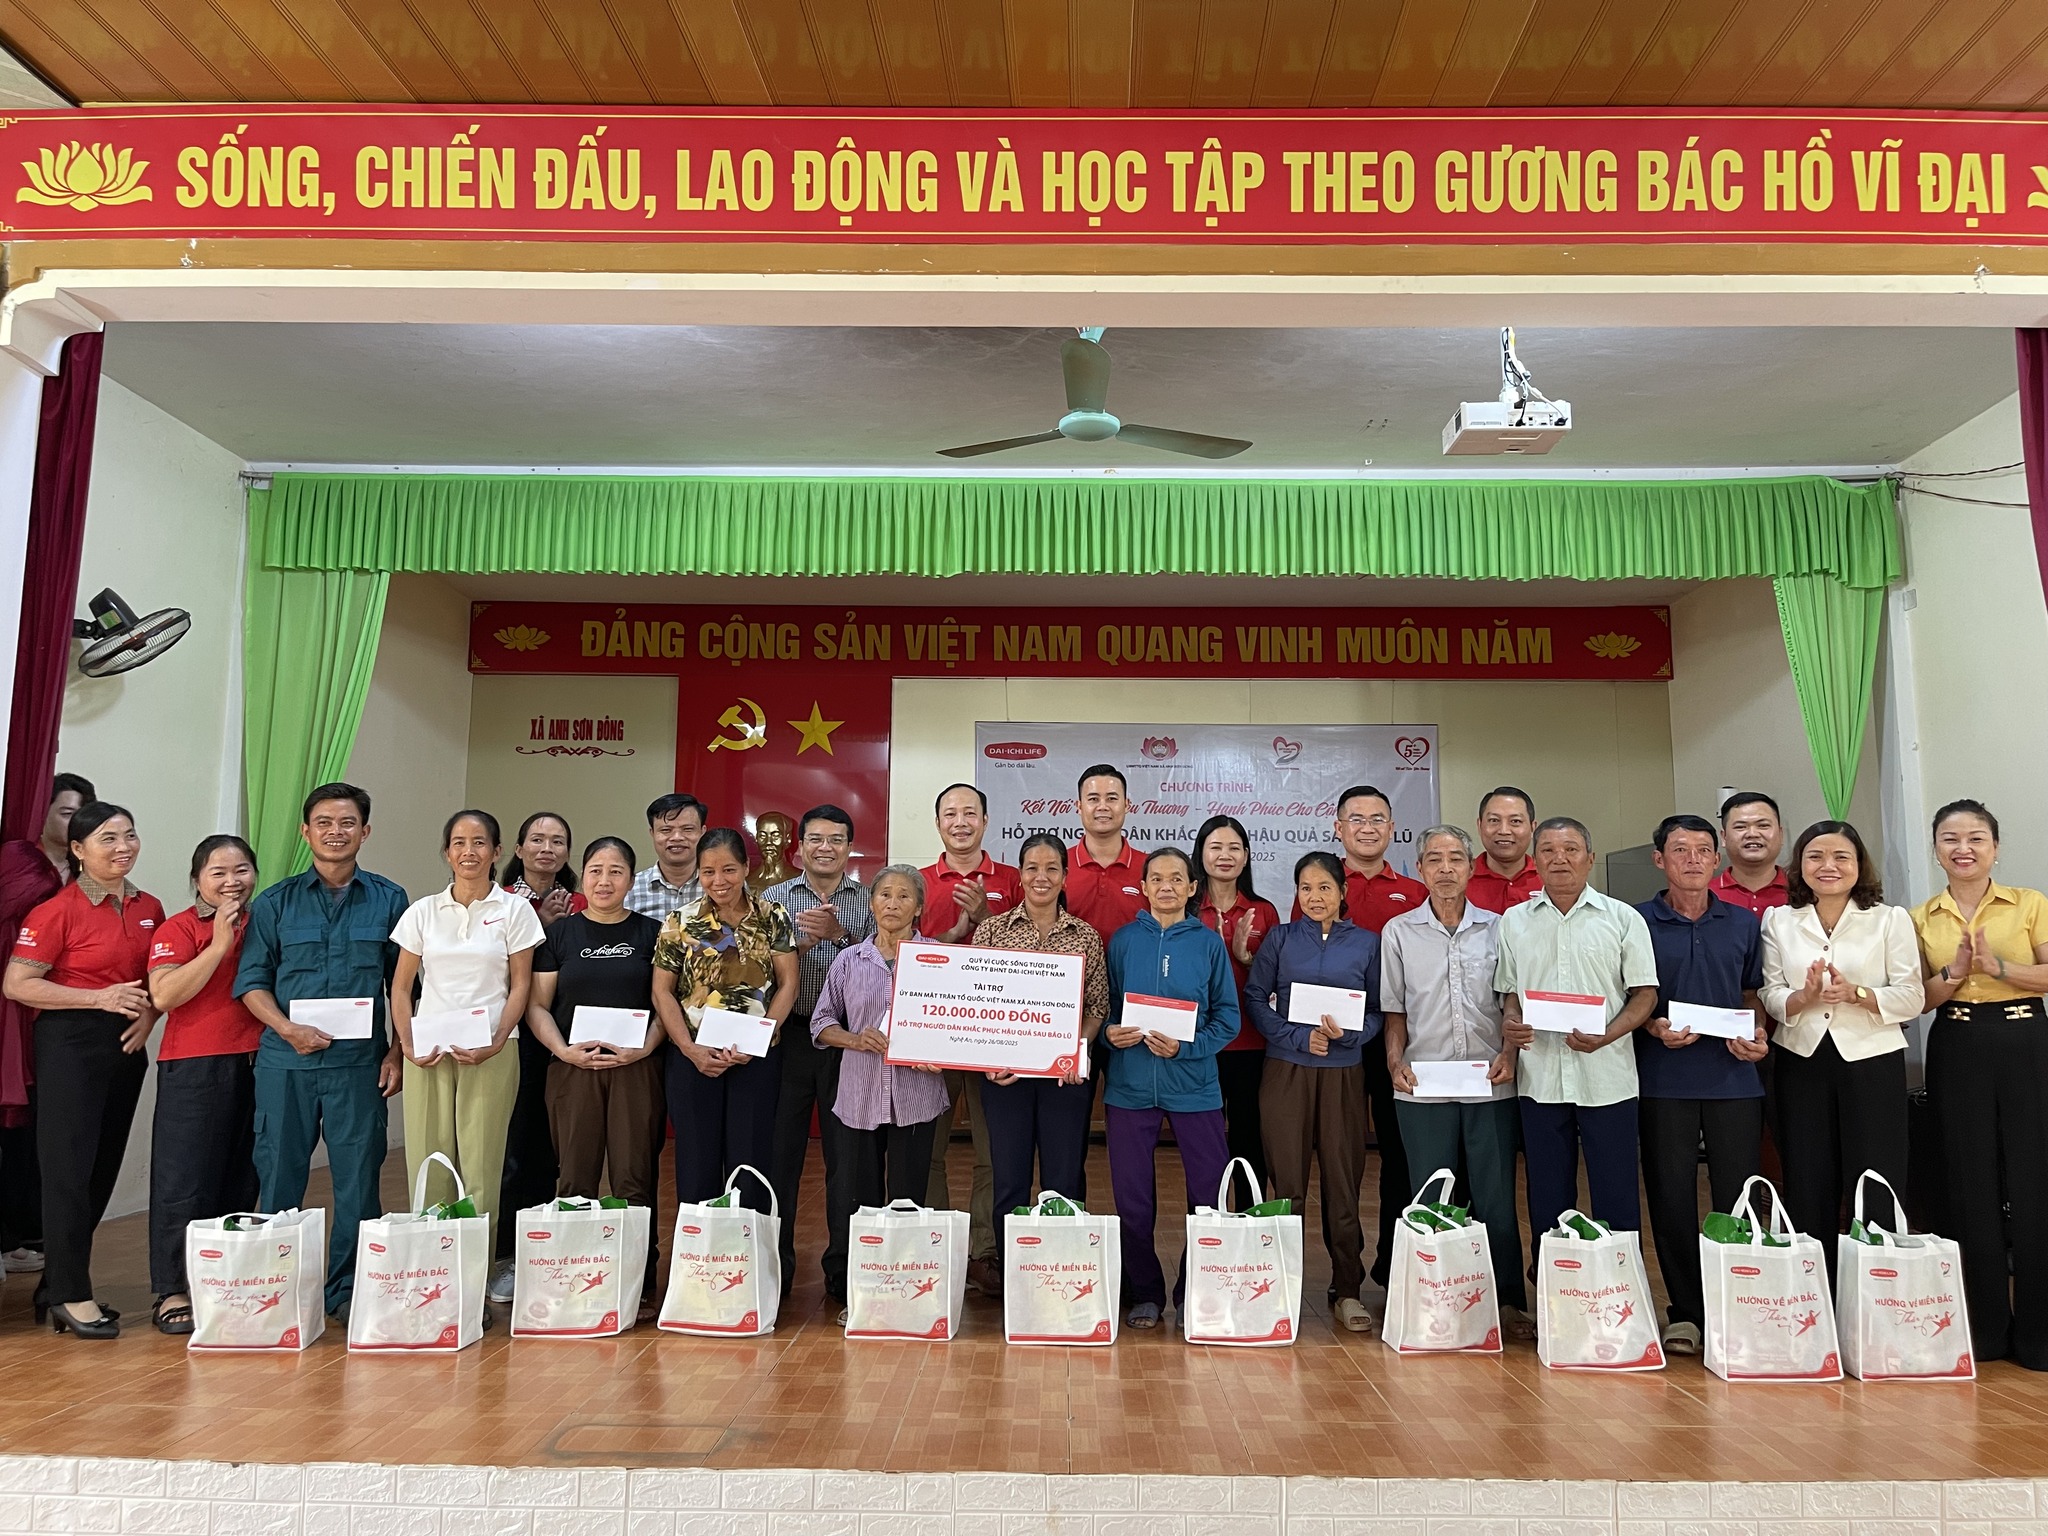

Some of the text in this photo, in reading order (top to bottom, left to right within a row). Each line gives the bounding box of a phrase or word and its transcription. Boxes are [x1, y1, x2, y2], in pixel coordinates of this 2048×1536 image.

[176, 124, 2006, 228] SỐNG, CHIẾN ĐẤU, LAO ĐỘNG VÀ HỌC TẬP THEO GƯƠNG BÁC HỒ VĨ ĐẠI
[581, 612, 1552, 668] ĐẢNG CỘNG SẢN VIỆT NAM QUANG VINH MUÔN NĂM
[530, 715, 624, 741] XÃ ANH SƠN ĐÔNG
[1160, 781, 1254, 793] CHƯƠNG TRÌNH
[1020, 798, 1045, 816] Kết
[1046, 798, 1073, 816] Nối
[1141, 799, 1190, 817] Thương
[1249, 801, 1284, 816] Phúc
[1285, 801, 1312, 817] Cho
[1314, 801, 1339, 819] Cộn
[1002, 822, 1025, 840] HỖ
[1155, 824, 1197, 841] KHẮC
[1248, 826, 1342, 845] HẬU QUẢ SA
[1393, 828, 1413, 843] LŨ
[1251, 851, 1276, 862] 2025
[991, 959, 1009, 967] CUỘC
[1010, 960, 1028, 968] SỐNG
[974, 983, 1004, 993] TÀI TRỢ
[922, 1004, 1051, 1024] 120.000.000 ĐỒNG
[982, 1027, 1000, 1035] PHỤC
[1002, 1028, 1016, 1036] HẬU
[594, 1254, 609, 1263] BẮC
[734, 1252, 749, 1262] BẮC
[924, 1260, 939, 1269] BẮC
[1083, 1262, 1097, 1271] BẮC
[1257, 1262, 1273, 1271] BẮC
[431, 1266, 448, 1276] BẮC
[1472, 1271, 1485, 1281] BẮC
[268, 1274, 287, 1284] BẮC
[1616, 1282, 1630, 1293] BẮC
[1801, 1291, 1817, 1302] BẮC
[1937, 1293, 1953, 1303] BẮC
